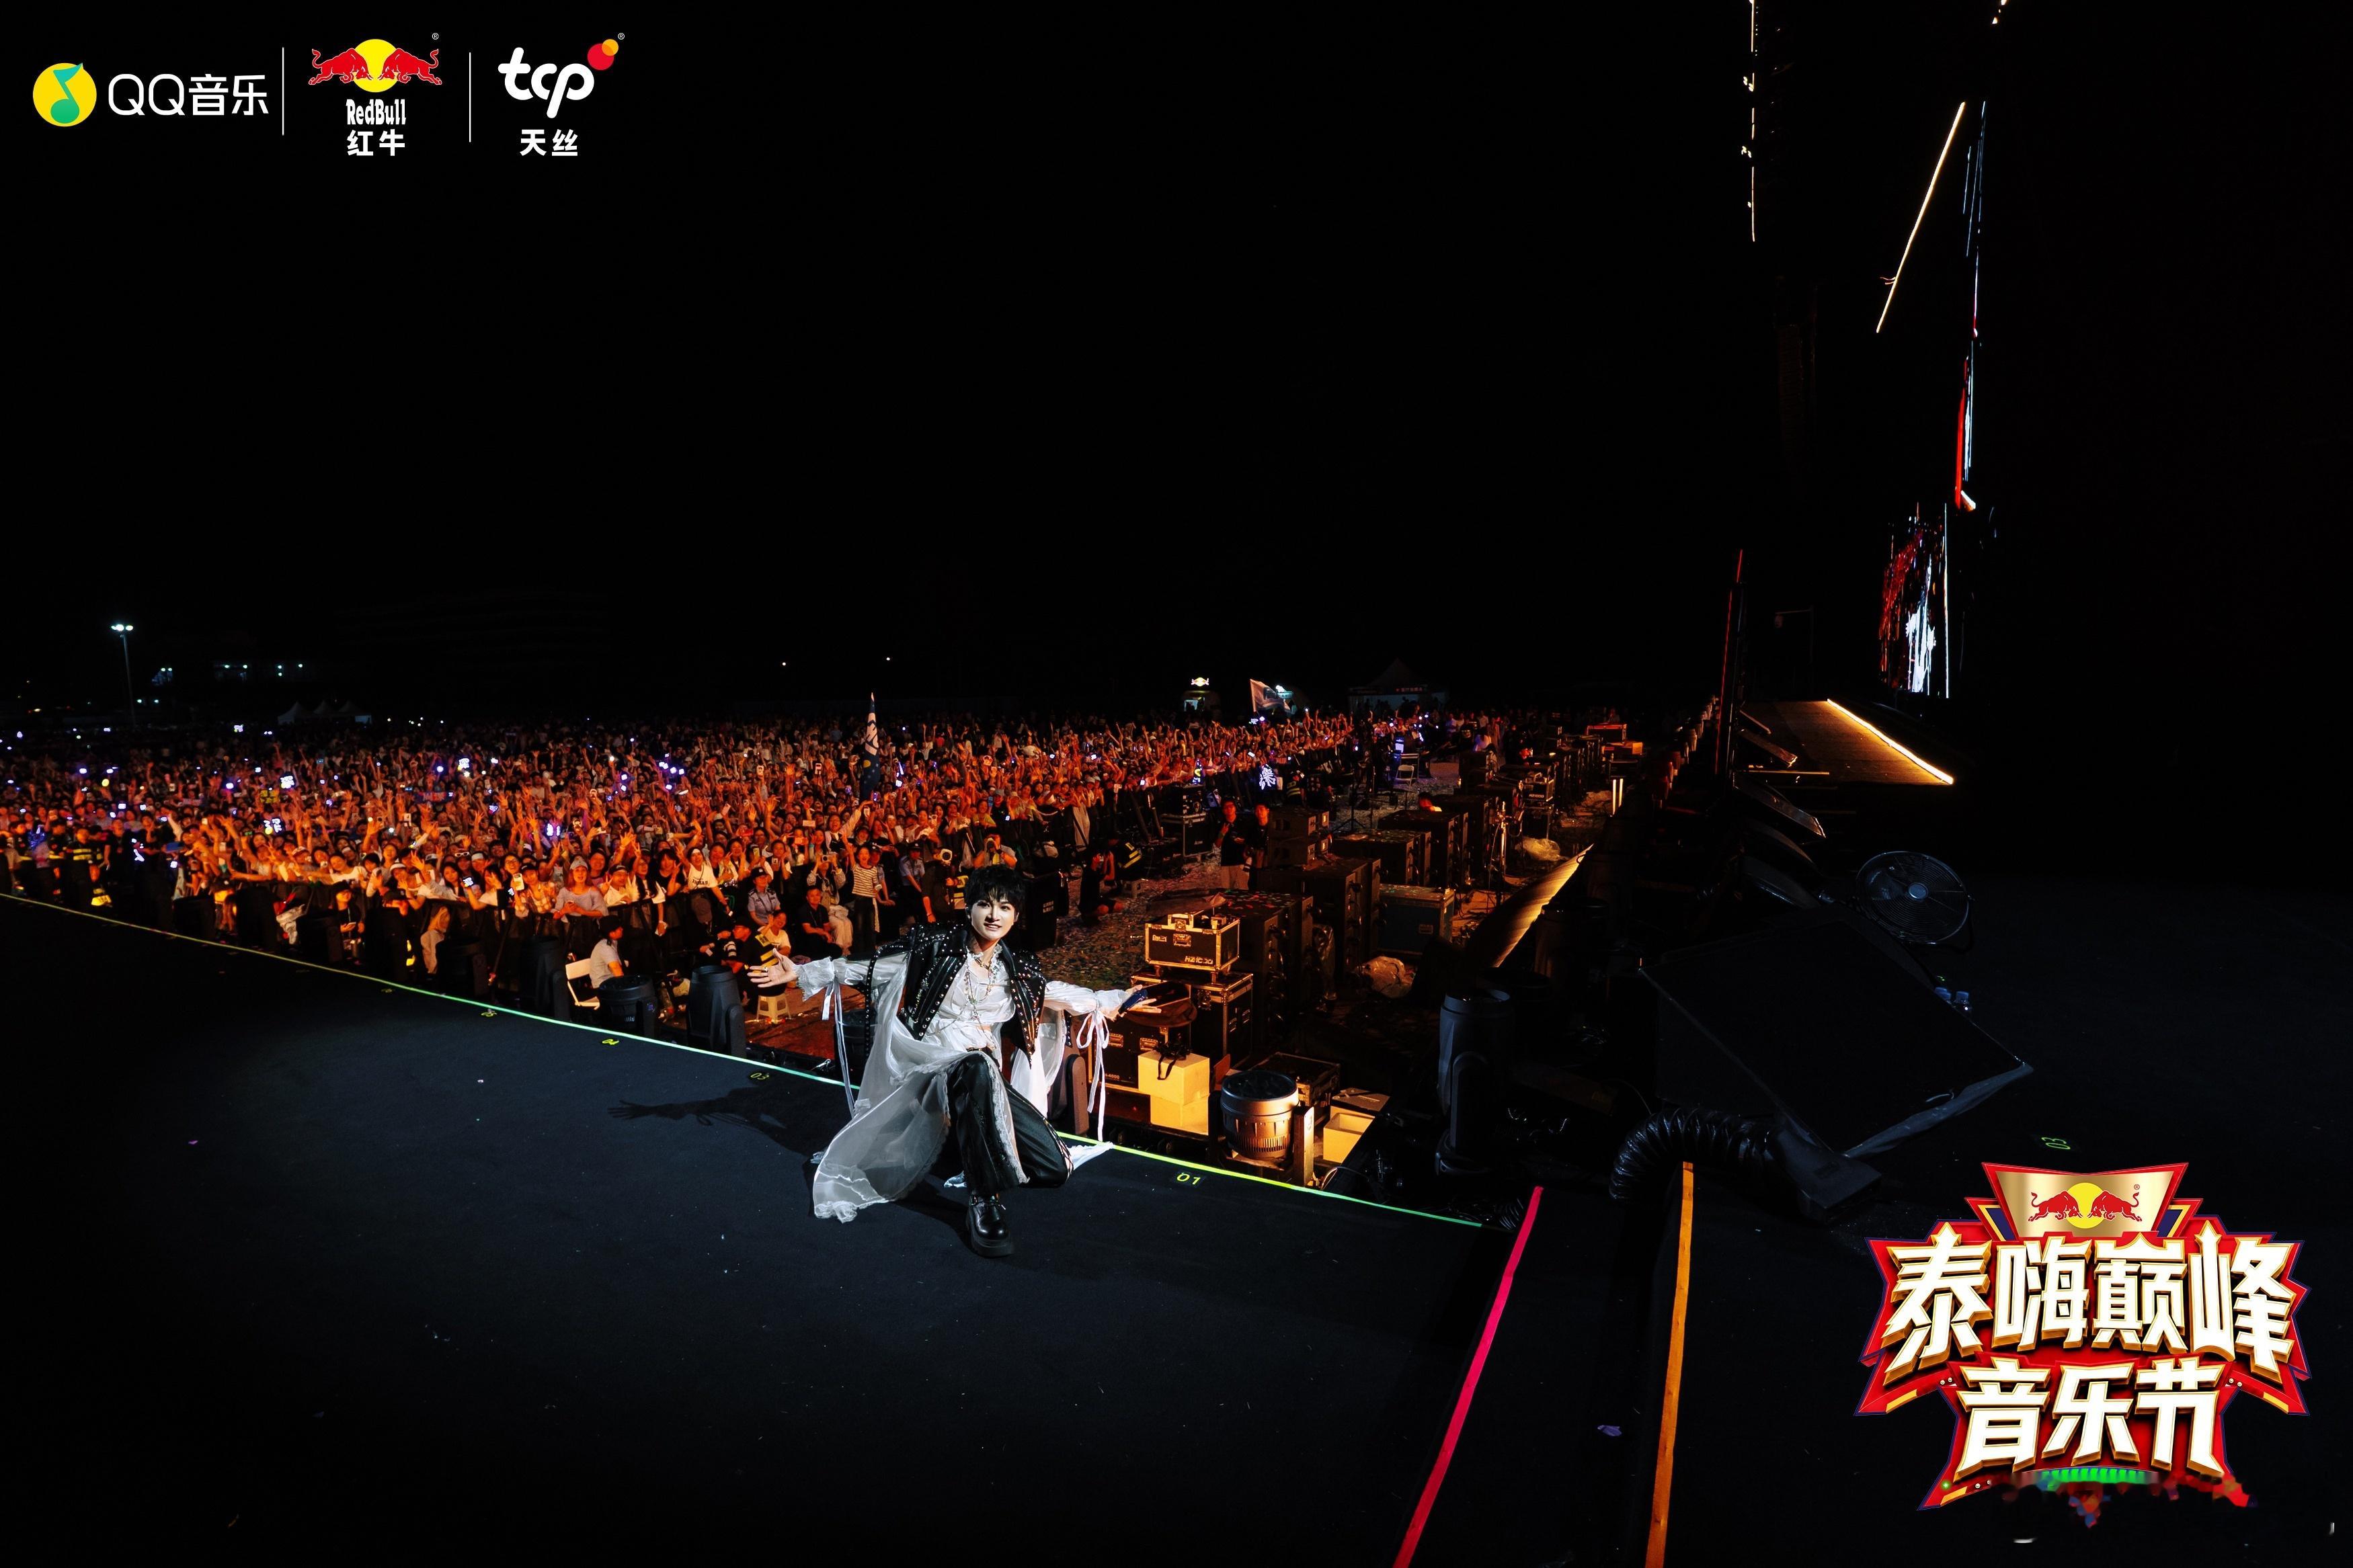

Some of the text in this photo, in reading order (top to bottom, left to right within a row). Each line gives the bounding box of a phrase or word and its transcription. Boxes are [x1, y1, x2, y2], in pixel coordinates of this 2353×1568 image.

[750, 1072, 770, 1080] 03
[2040, 1137, 2071, 1150] 03
[1176, 1172, 1201, 1185] 01
